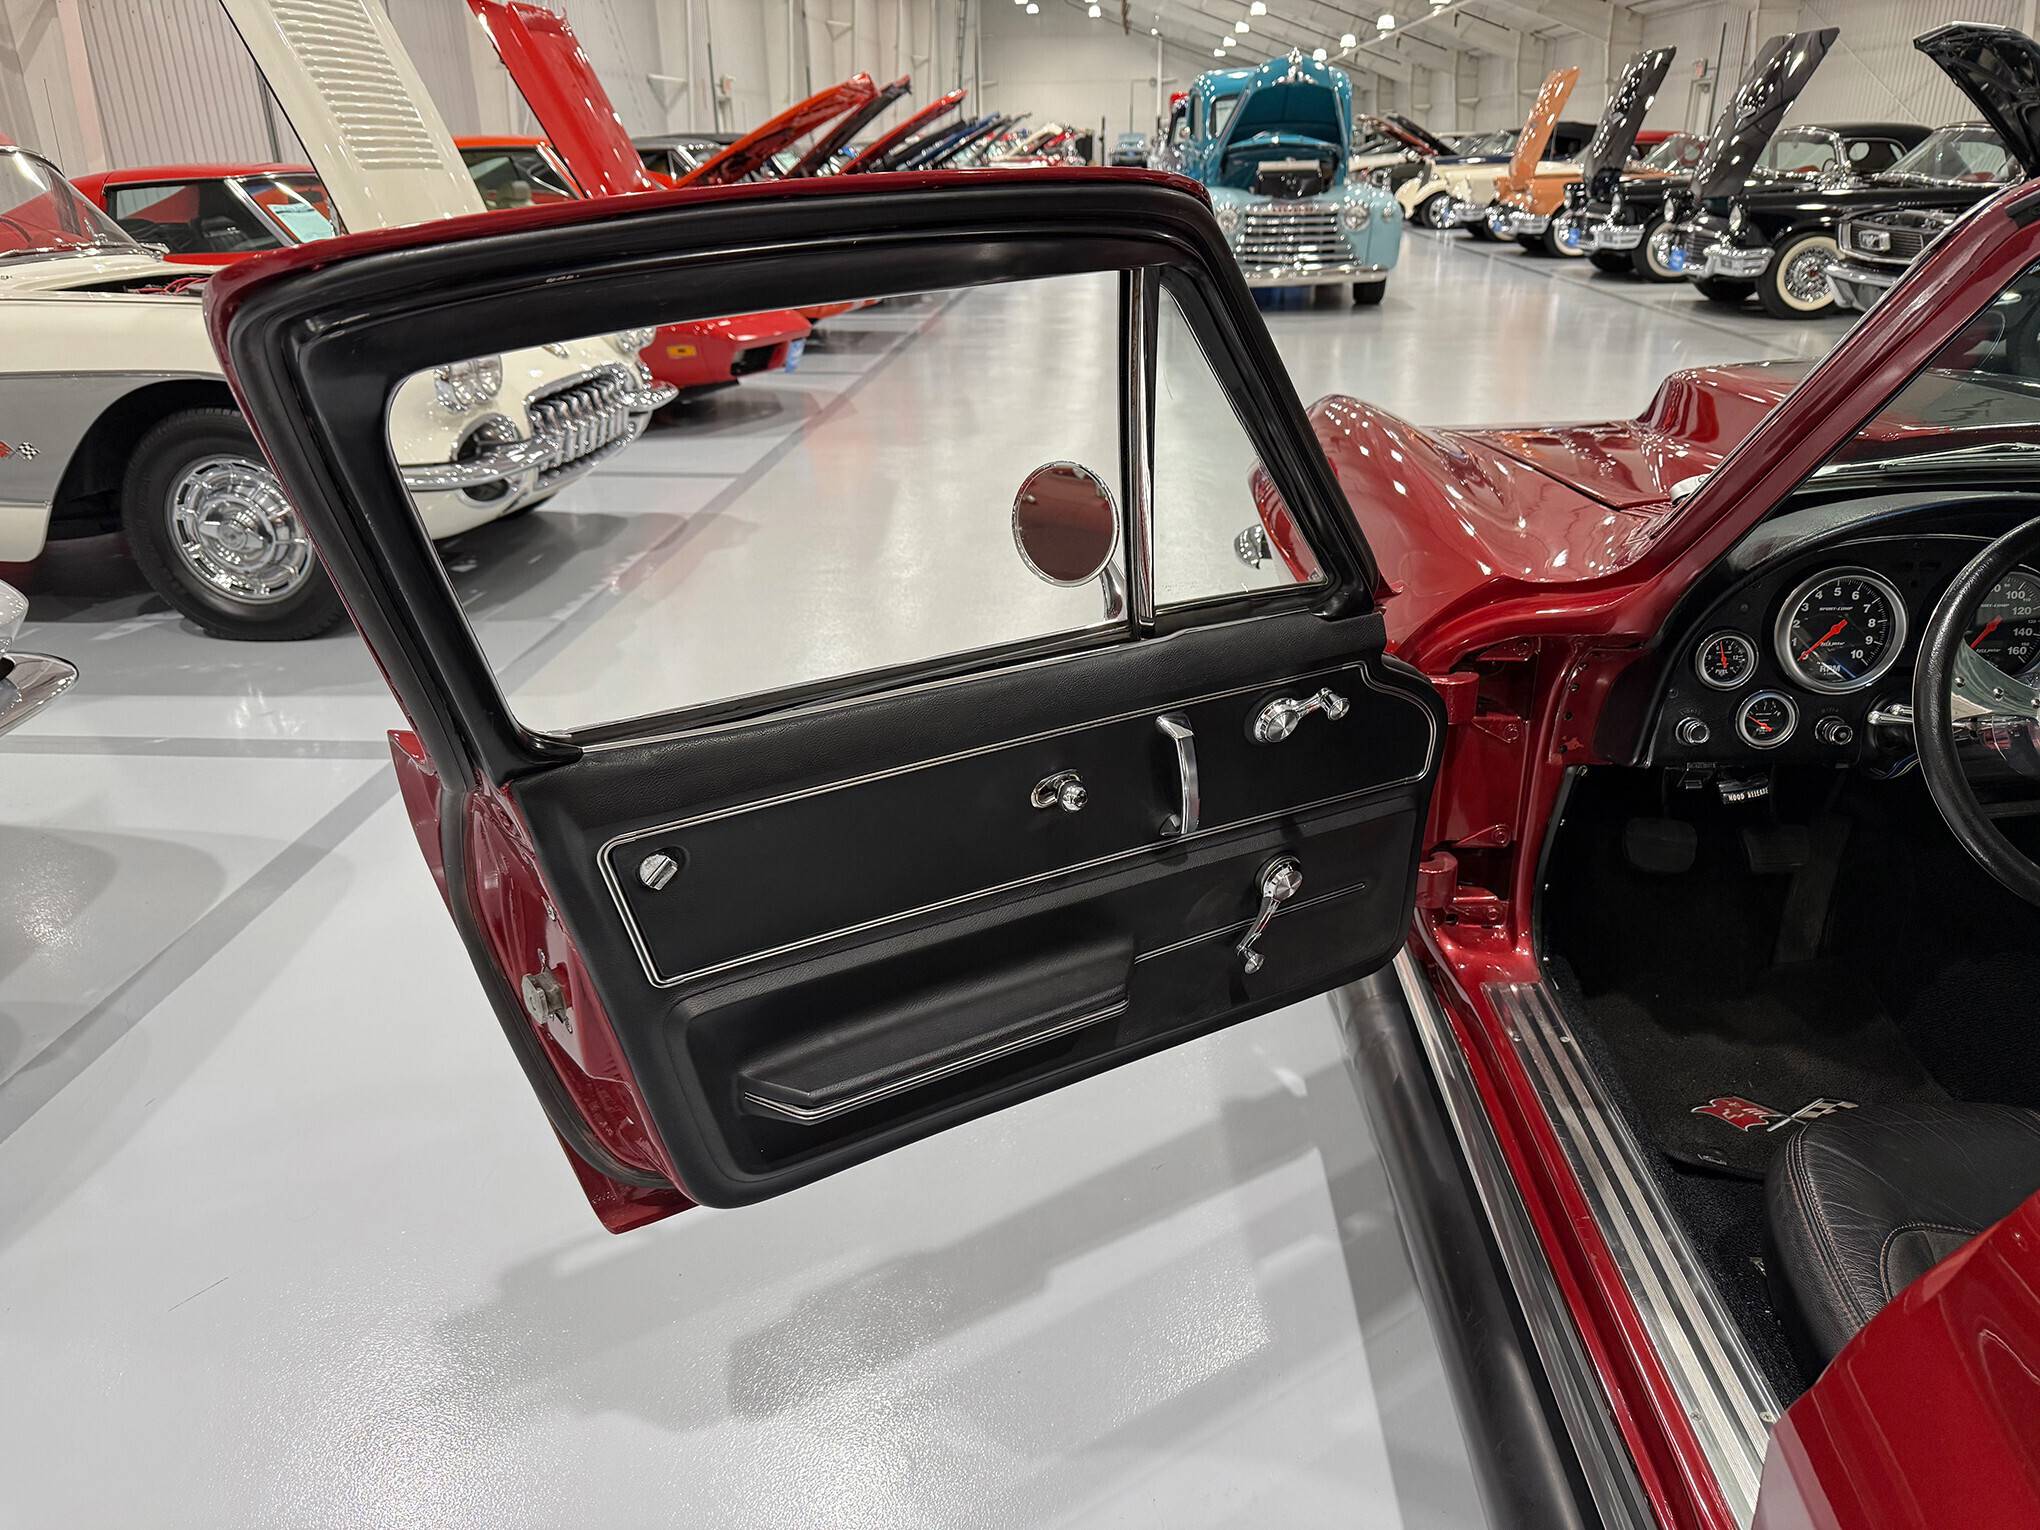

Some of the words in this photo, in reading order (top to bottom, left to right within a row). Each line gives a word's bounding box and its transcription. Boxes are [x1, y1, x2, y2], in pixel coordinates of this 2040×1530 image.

[1815, 590, 1823, 600] 4
[1833, 587, 1842, 597] 5
[1851, 591, 1860, 600] 6
[2005, 590, 2026, 600] 100
[1801, 602, 1809, 612] 3
[1863, 604, 1871, 613] 7
[2012, 606, 2032, 616] 120
[1792, 619, 1800, 629] 2
[1867, 618, 1876, 628] 8
[2013, 627, 2033, 636] 140
[1791, 637, 1797, 647] 1
[1865, 635, 1873, 645] 9
[1850, 649, 1863, 659] 10
[2007, 646, 2027, 655] 160
[1819, 664, 1841, 673] RPM
